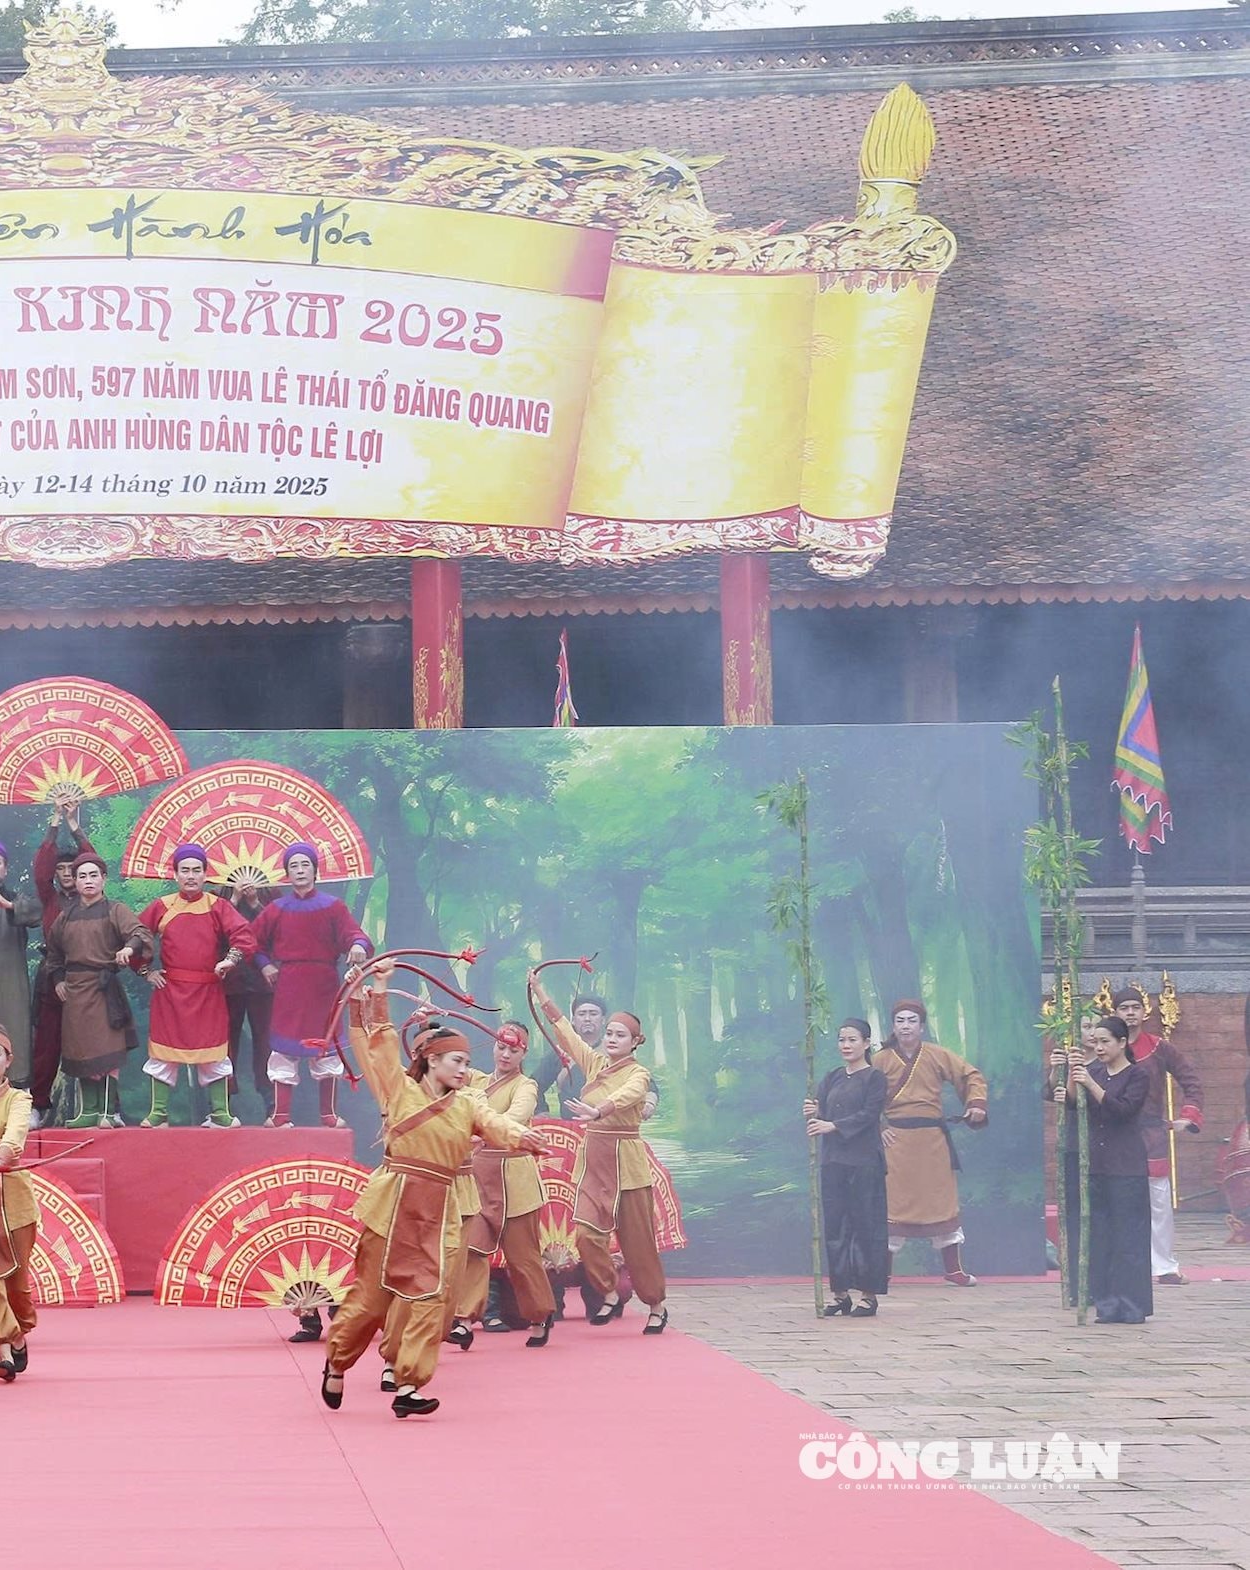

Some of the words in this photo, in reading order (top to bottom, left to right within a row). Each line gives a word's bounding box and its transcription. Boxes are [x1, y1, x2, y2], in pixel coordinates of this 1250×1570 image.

[86, 193, 246, 261] Hành
[275, 197, 373, 265] Hóa
[14, 286, 173, 342] KINH
[193, 278, 345, 340] NĂM
[360, 300, 503, 356] 2025
[26, 365, 83, 402] SƠN,
[91, 367, 136, 400] 597
[143, 363, 199, 400] NĂM
[208, 370, 252, 402] VUA
[261, 365, 288, 404] LÊ
[297, 370, 350, 409] THÁI
[358, 368, 390, 412] TỔ
[394, 374, 460, 421] ĐĂNG
[468, 396, 551, 435] QUANG
[10, 406, 59, 452] CỦA
[67, 418, 117, 450] ANH
[125, 412, 191, 452] HÙNG
[199, 418, 249, 454] DÂN
[257, 418, 302, 463] TỘC
[310, 420, 338, 460] LÊ
[347, 428, 383, 470] LỢI
[34, 474, 93, 495] 12-14
[101, 474, 173, 497] tháng
[181, 475, 206, 494] 10
[214, 477, 267, 495] năm
[273, 477, 329, 497] 2025
